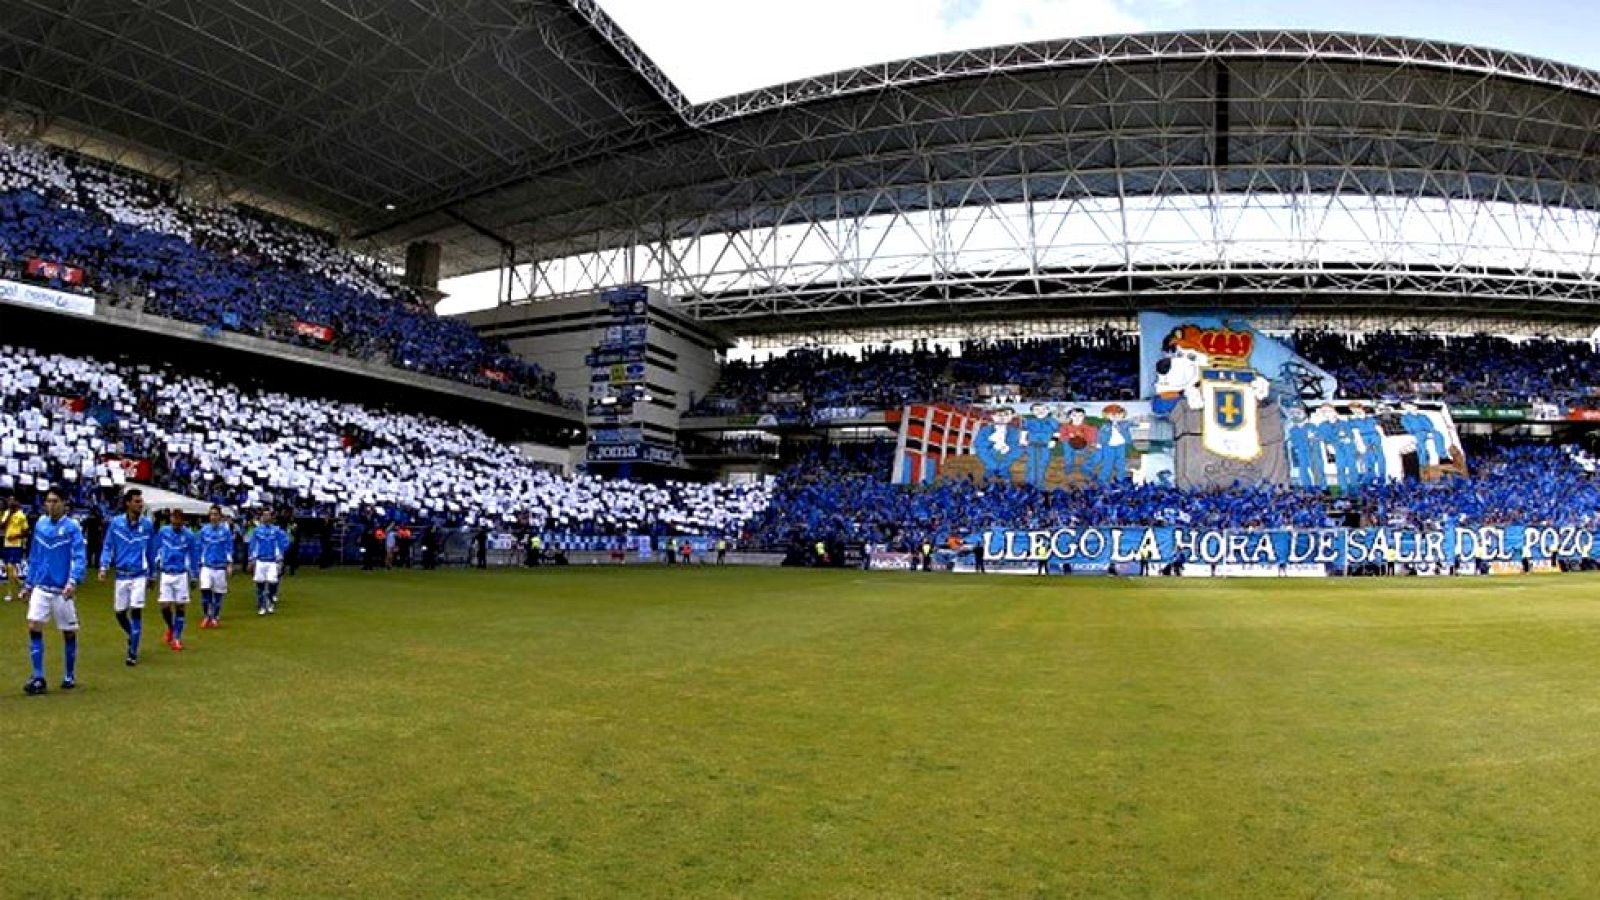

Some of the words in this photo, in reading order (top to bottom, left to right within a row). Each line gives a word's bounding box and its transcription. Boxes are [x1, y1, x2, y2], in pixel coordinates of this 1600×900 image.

[983, 528, 1104, 560] LLEGO
[1109, 528, 1161, 561] LA
[1175, 528, 1276, 563] HORA
[1288, 531, 1338, 562] DE
[1347, 528, 1446, 563] SALIR
[1455, 527, 1512, 561] DEL
[1522, 527, 1592, 558] POZO
